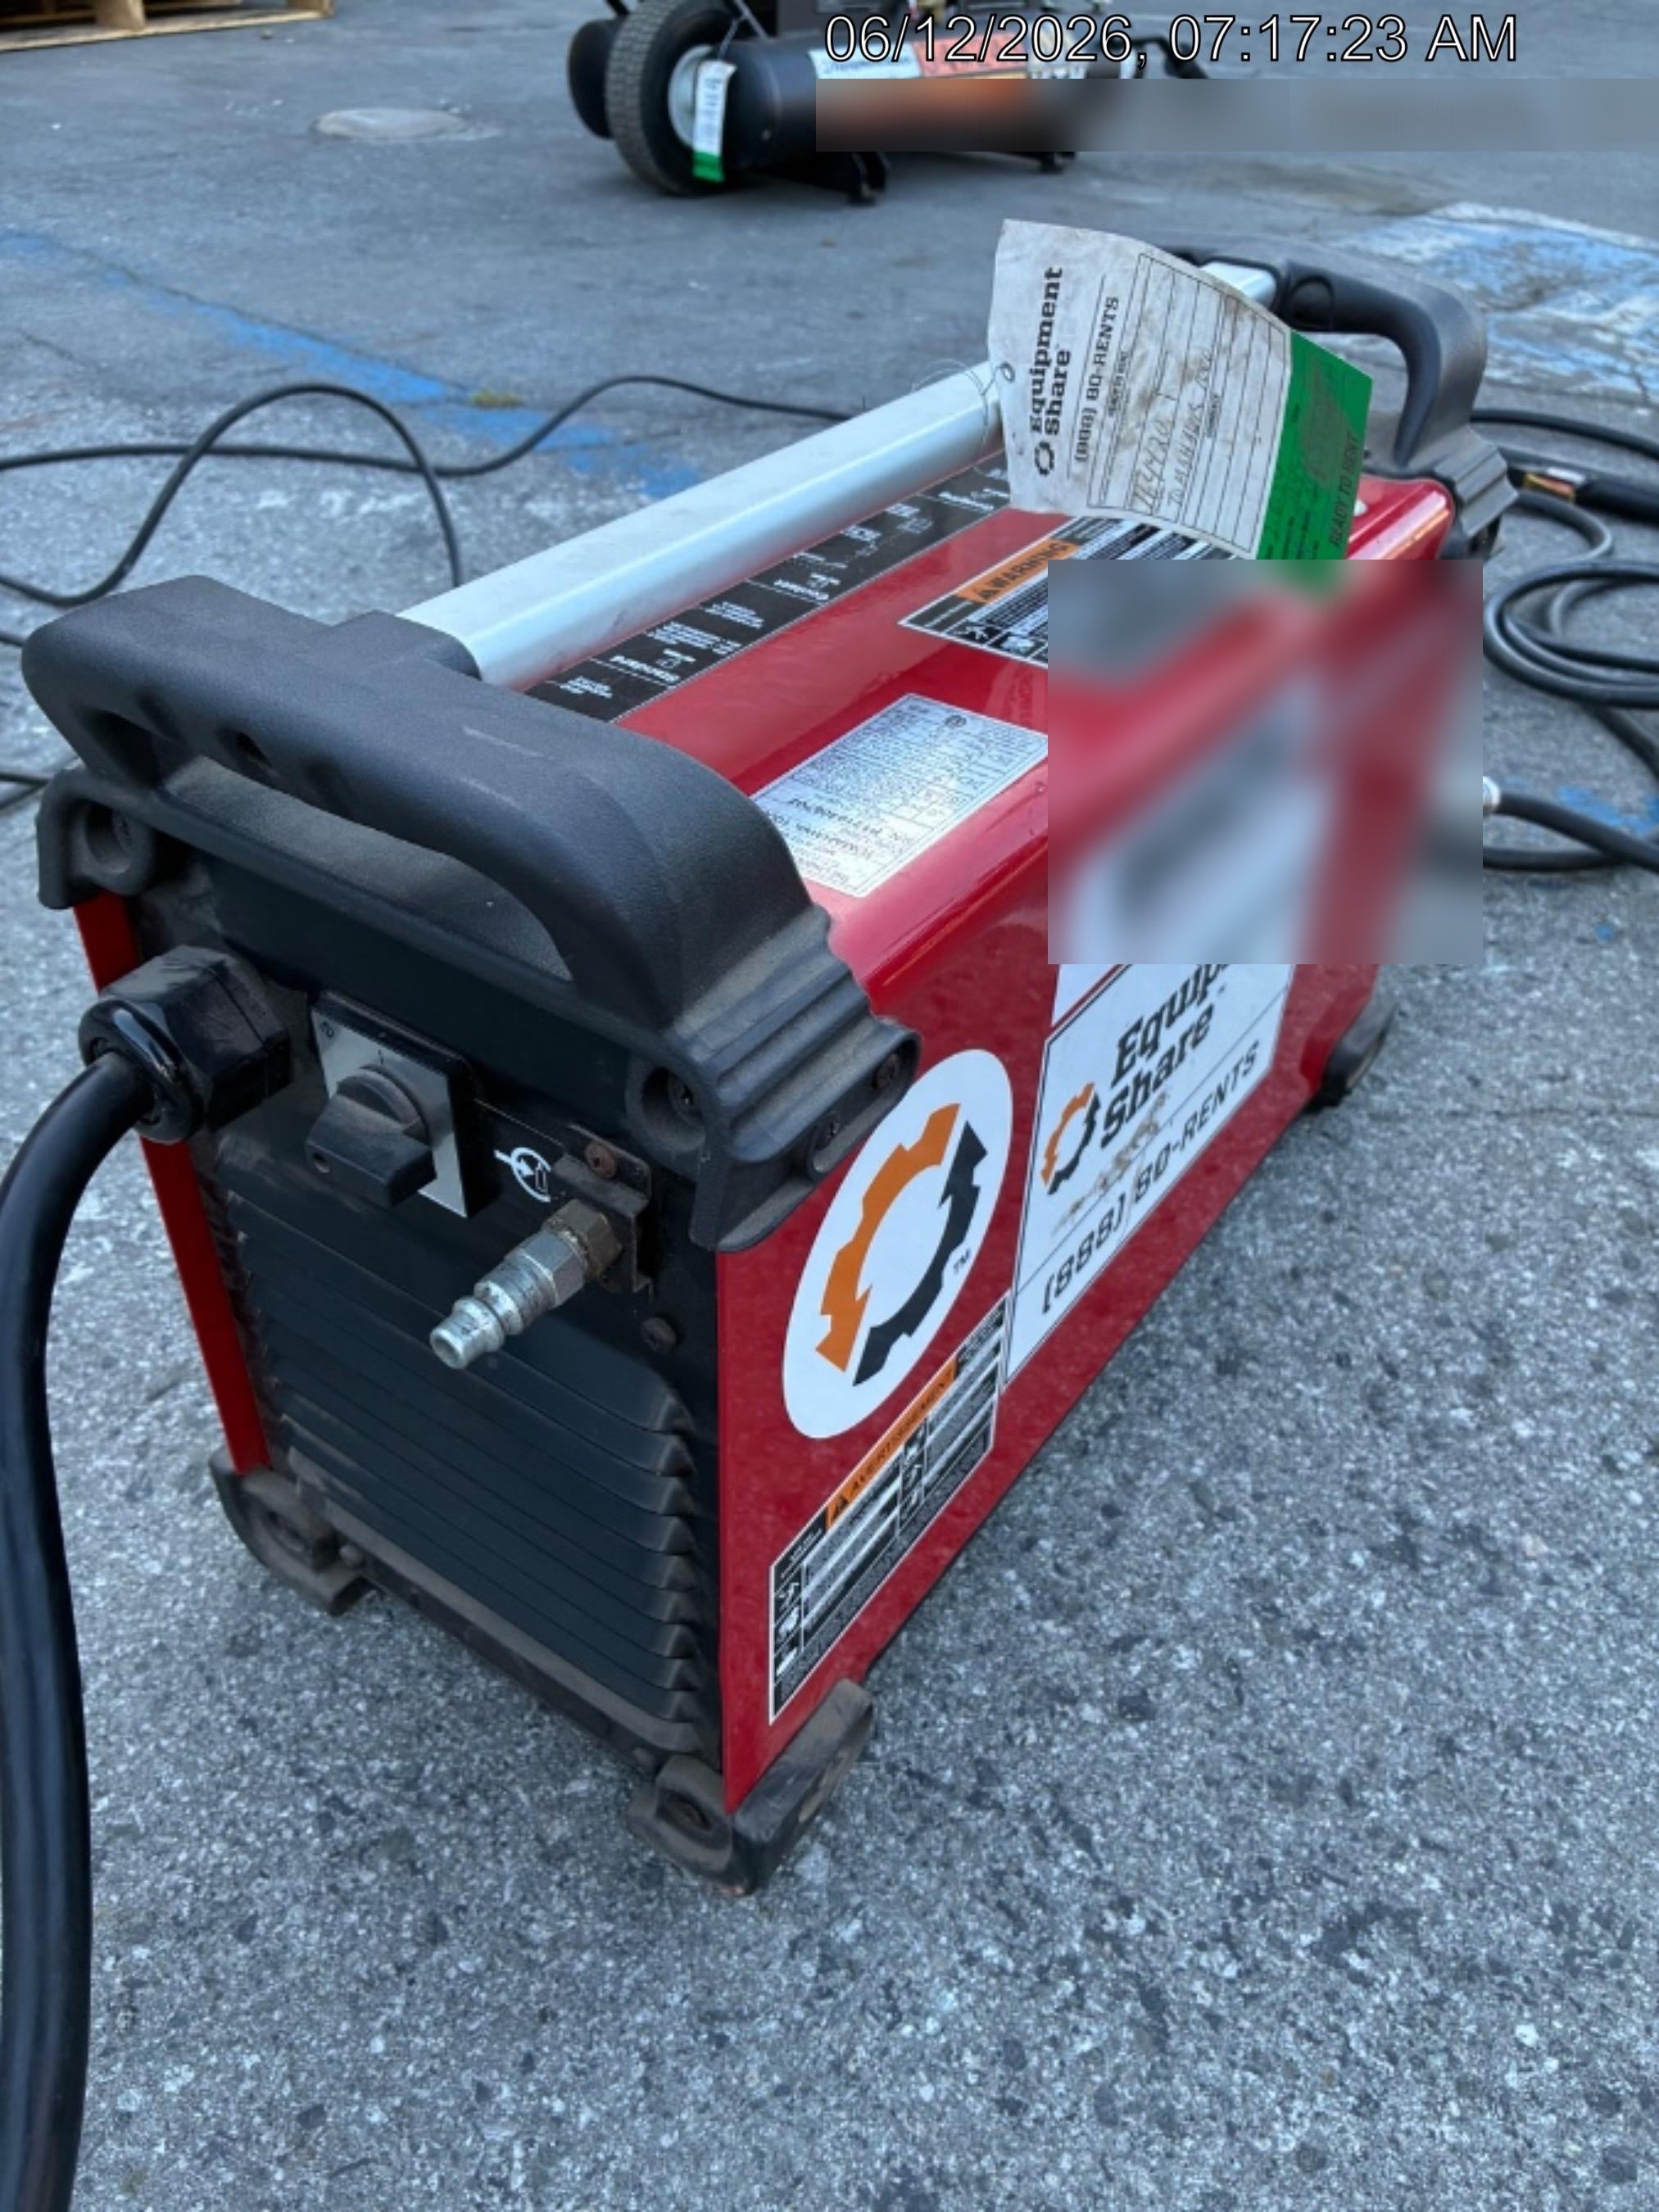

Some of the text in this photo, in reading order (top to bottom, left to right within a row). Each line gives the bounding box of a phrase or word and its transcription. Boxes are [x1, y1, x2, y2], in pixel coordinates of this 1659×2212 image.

[1029, 266, 1063, 434] Equipment
[1045, 349, 1072, 436] Share
[1074, 407, 1098, 463] (888)
[988, 542, 1069, 589] WARNING
[1329, 498, 1346, 547] READY
[1100, 1003, 1215, 1149] Share
[1111, 964, 1231, 1090] Equip
[1042, 1040, 1260, 1314] (888) 80-RENTS
